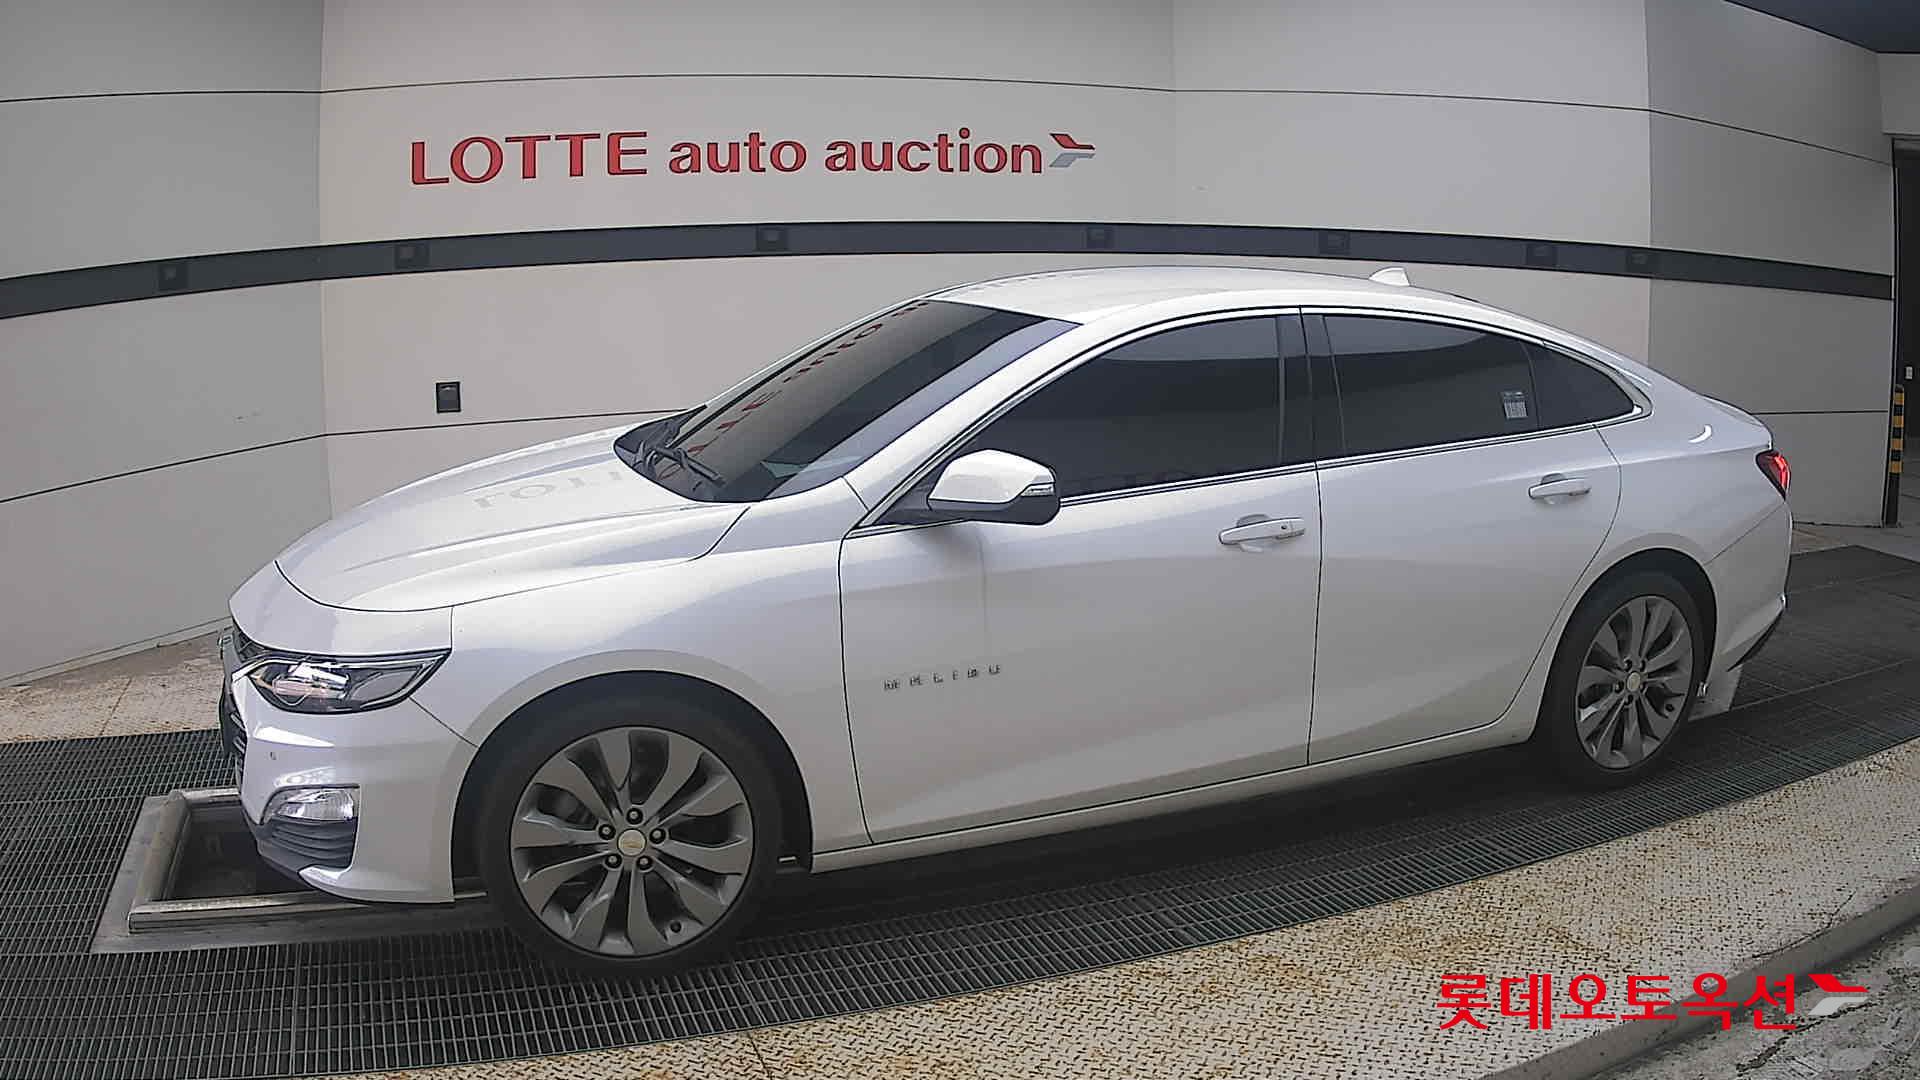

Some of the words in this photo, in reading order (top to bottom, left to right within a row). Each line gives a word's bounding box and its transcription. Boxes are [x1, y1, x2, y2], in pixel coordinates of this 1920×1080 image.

[410, 131, 648, 185] LOTTE
[668, 131, 807, 174] auto
[824, 127, 1042, 173] auction
